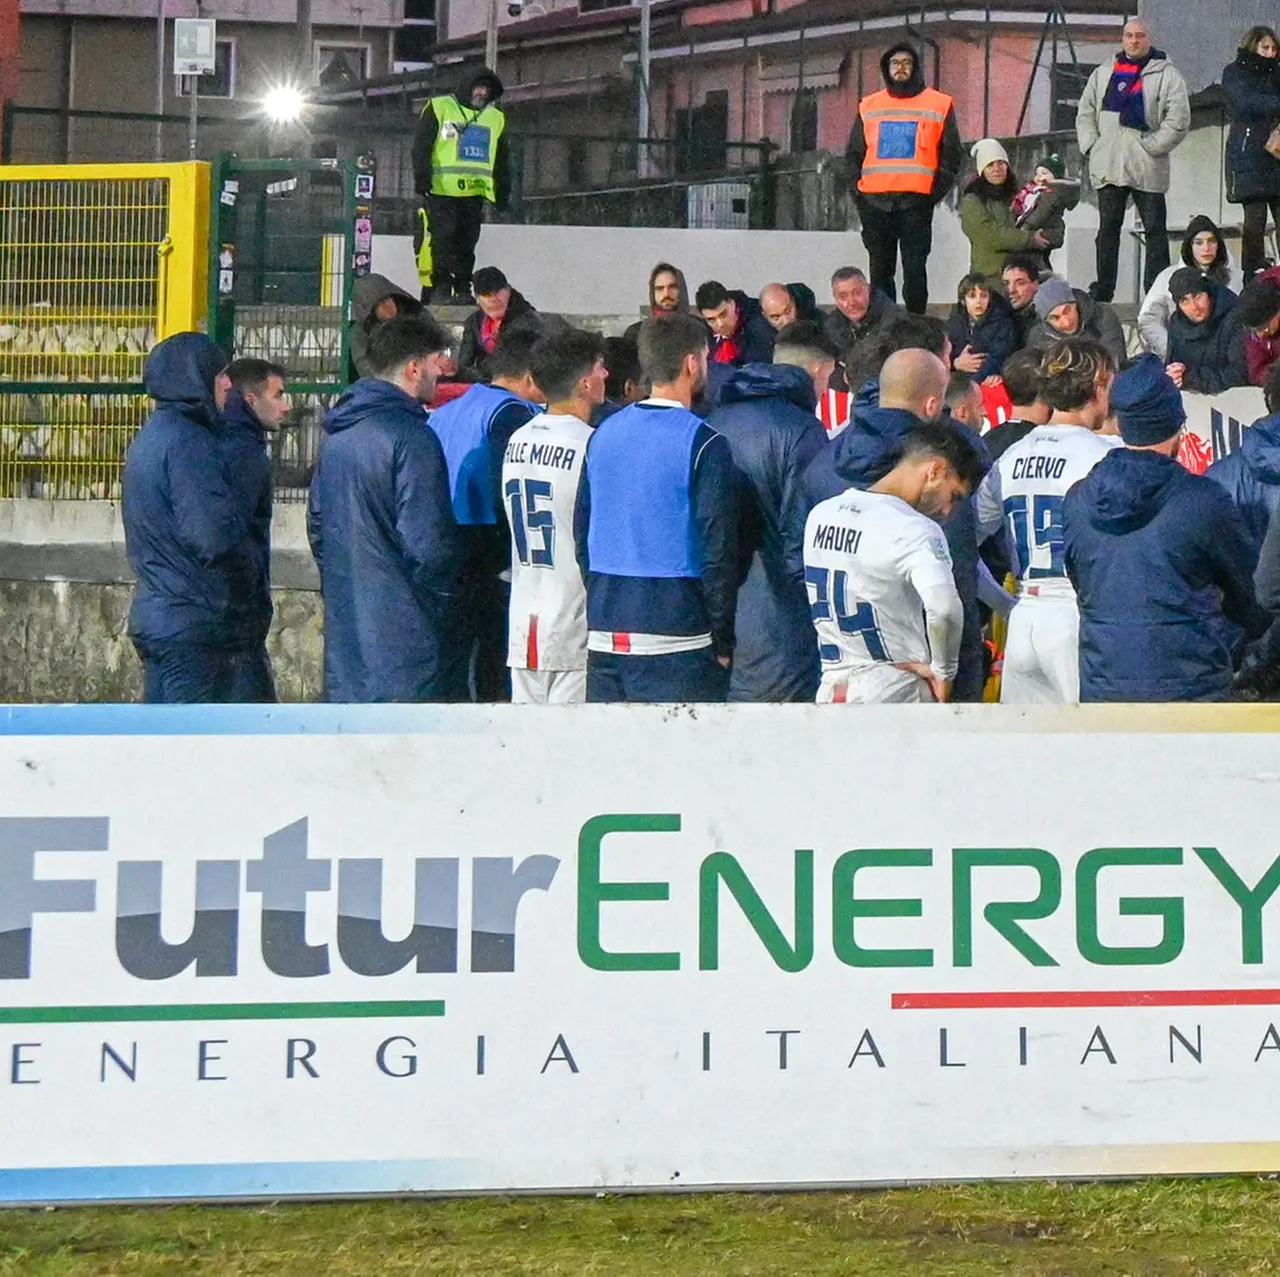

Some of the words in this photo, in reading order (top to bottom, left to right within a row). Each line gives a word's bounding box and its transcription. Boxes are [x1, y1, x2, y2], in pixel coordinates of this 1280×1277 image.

[530, 443, 577, 471] MURA
[1012, 456, 1067, 480] CIERVO
[505, 478, 555, 570] 15
[813, 524, 862, 555] MAURI
[805, 565, 894, 665] 24
[11, 1033, 579, 1085] ENERGIA
